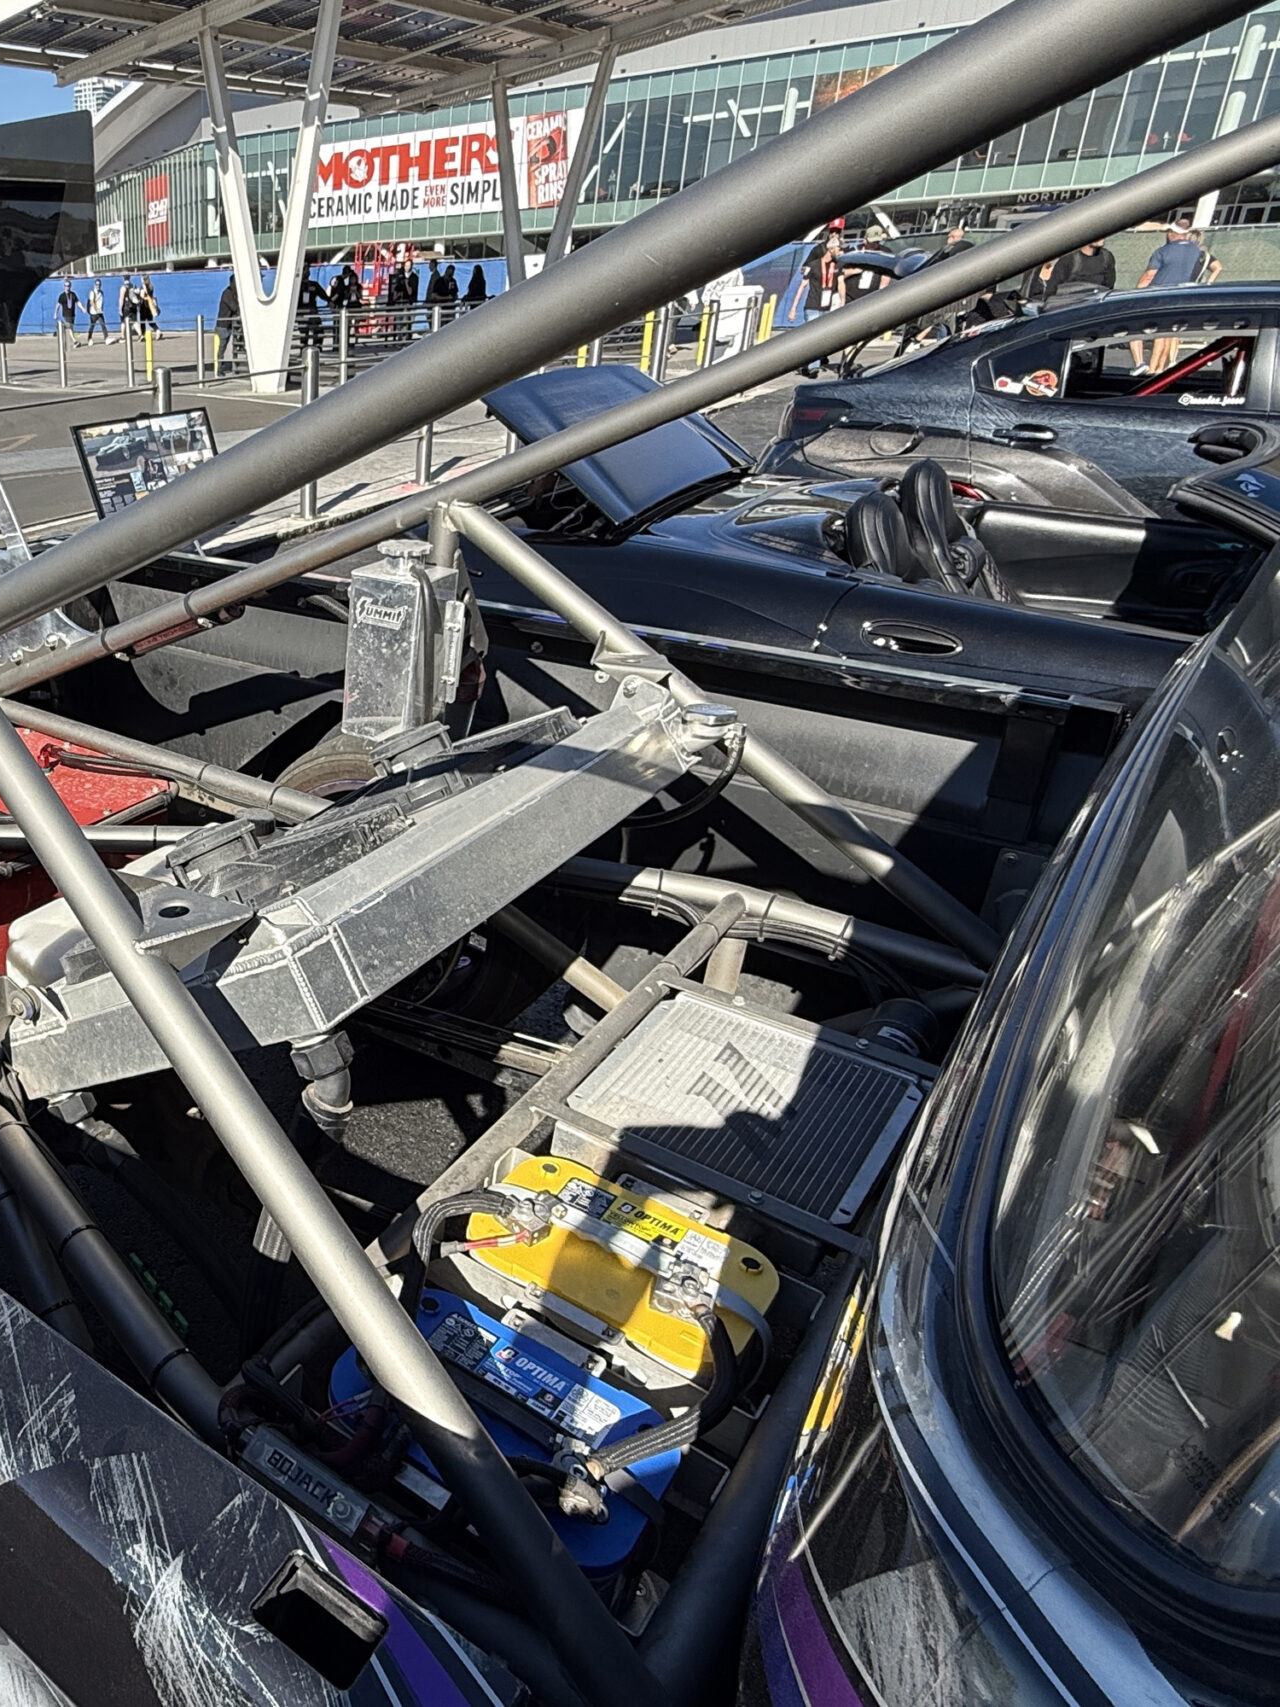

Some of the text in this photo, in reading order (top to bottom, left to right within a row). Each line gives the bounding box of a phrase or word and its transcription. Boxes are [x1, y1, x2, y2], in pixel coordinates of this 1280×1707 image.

[526, 113, 567, 141] CERAMIC
[310, 187, 419, 218] CERAMIC MADE
[423, 195, 446, 208] MORE
[425, 184, 446, 197] EVEN
[450, 178, 500, 206] SIMPL
[538, 179, 567, 204] RINS
[1016, 190, 1070, 203] NORTH
[634, 1210, 680, 1236] OPTIMA
[515, 1357, 567, 1392] OPTIMA
